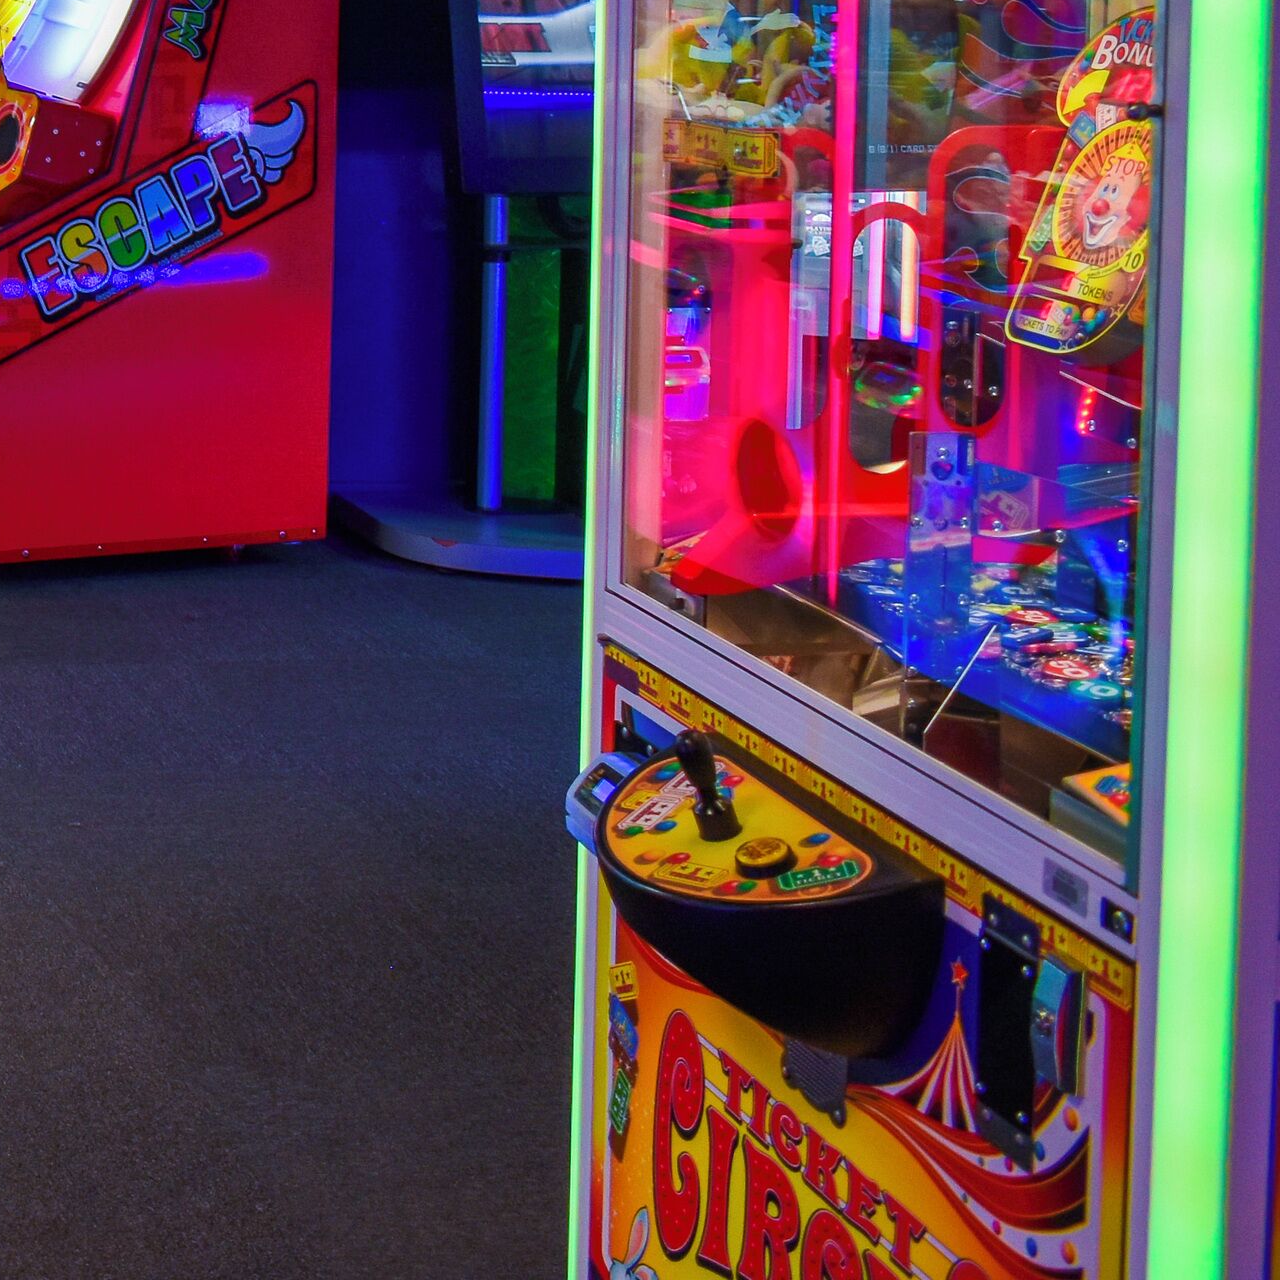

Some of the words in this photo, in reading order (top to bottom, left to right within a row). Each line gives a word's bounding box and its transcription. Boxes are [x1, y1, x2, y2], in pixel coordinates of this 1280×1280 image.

[1119, 16, 1154, 43] TICK
[1092, 35, 1155, 70] BONU
[1104, 155, 1146, 176] STOP
[20, 131, 263, 318] ESCAPE
[1124, 251, 1142, 269] 10
[1077, 282, 1114, 303] TOKENS
[1048, 659, 1091, 678] 50
[1076, 681, 1120, 697] 10
[654, 1008, 990, 1280] CIRC
[718, 1047, 928, 1276] TICKET
